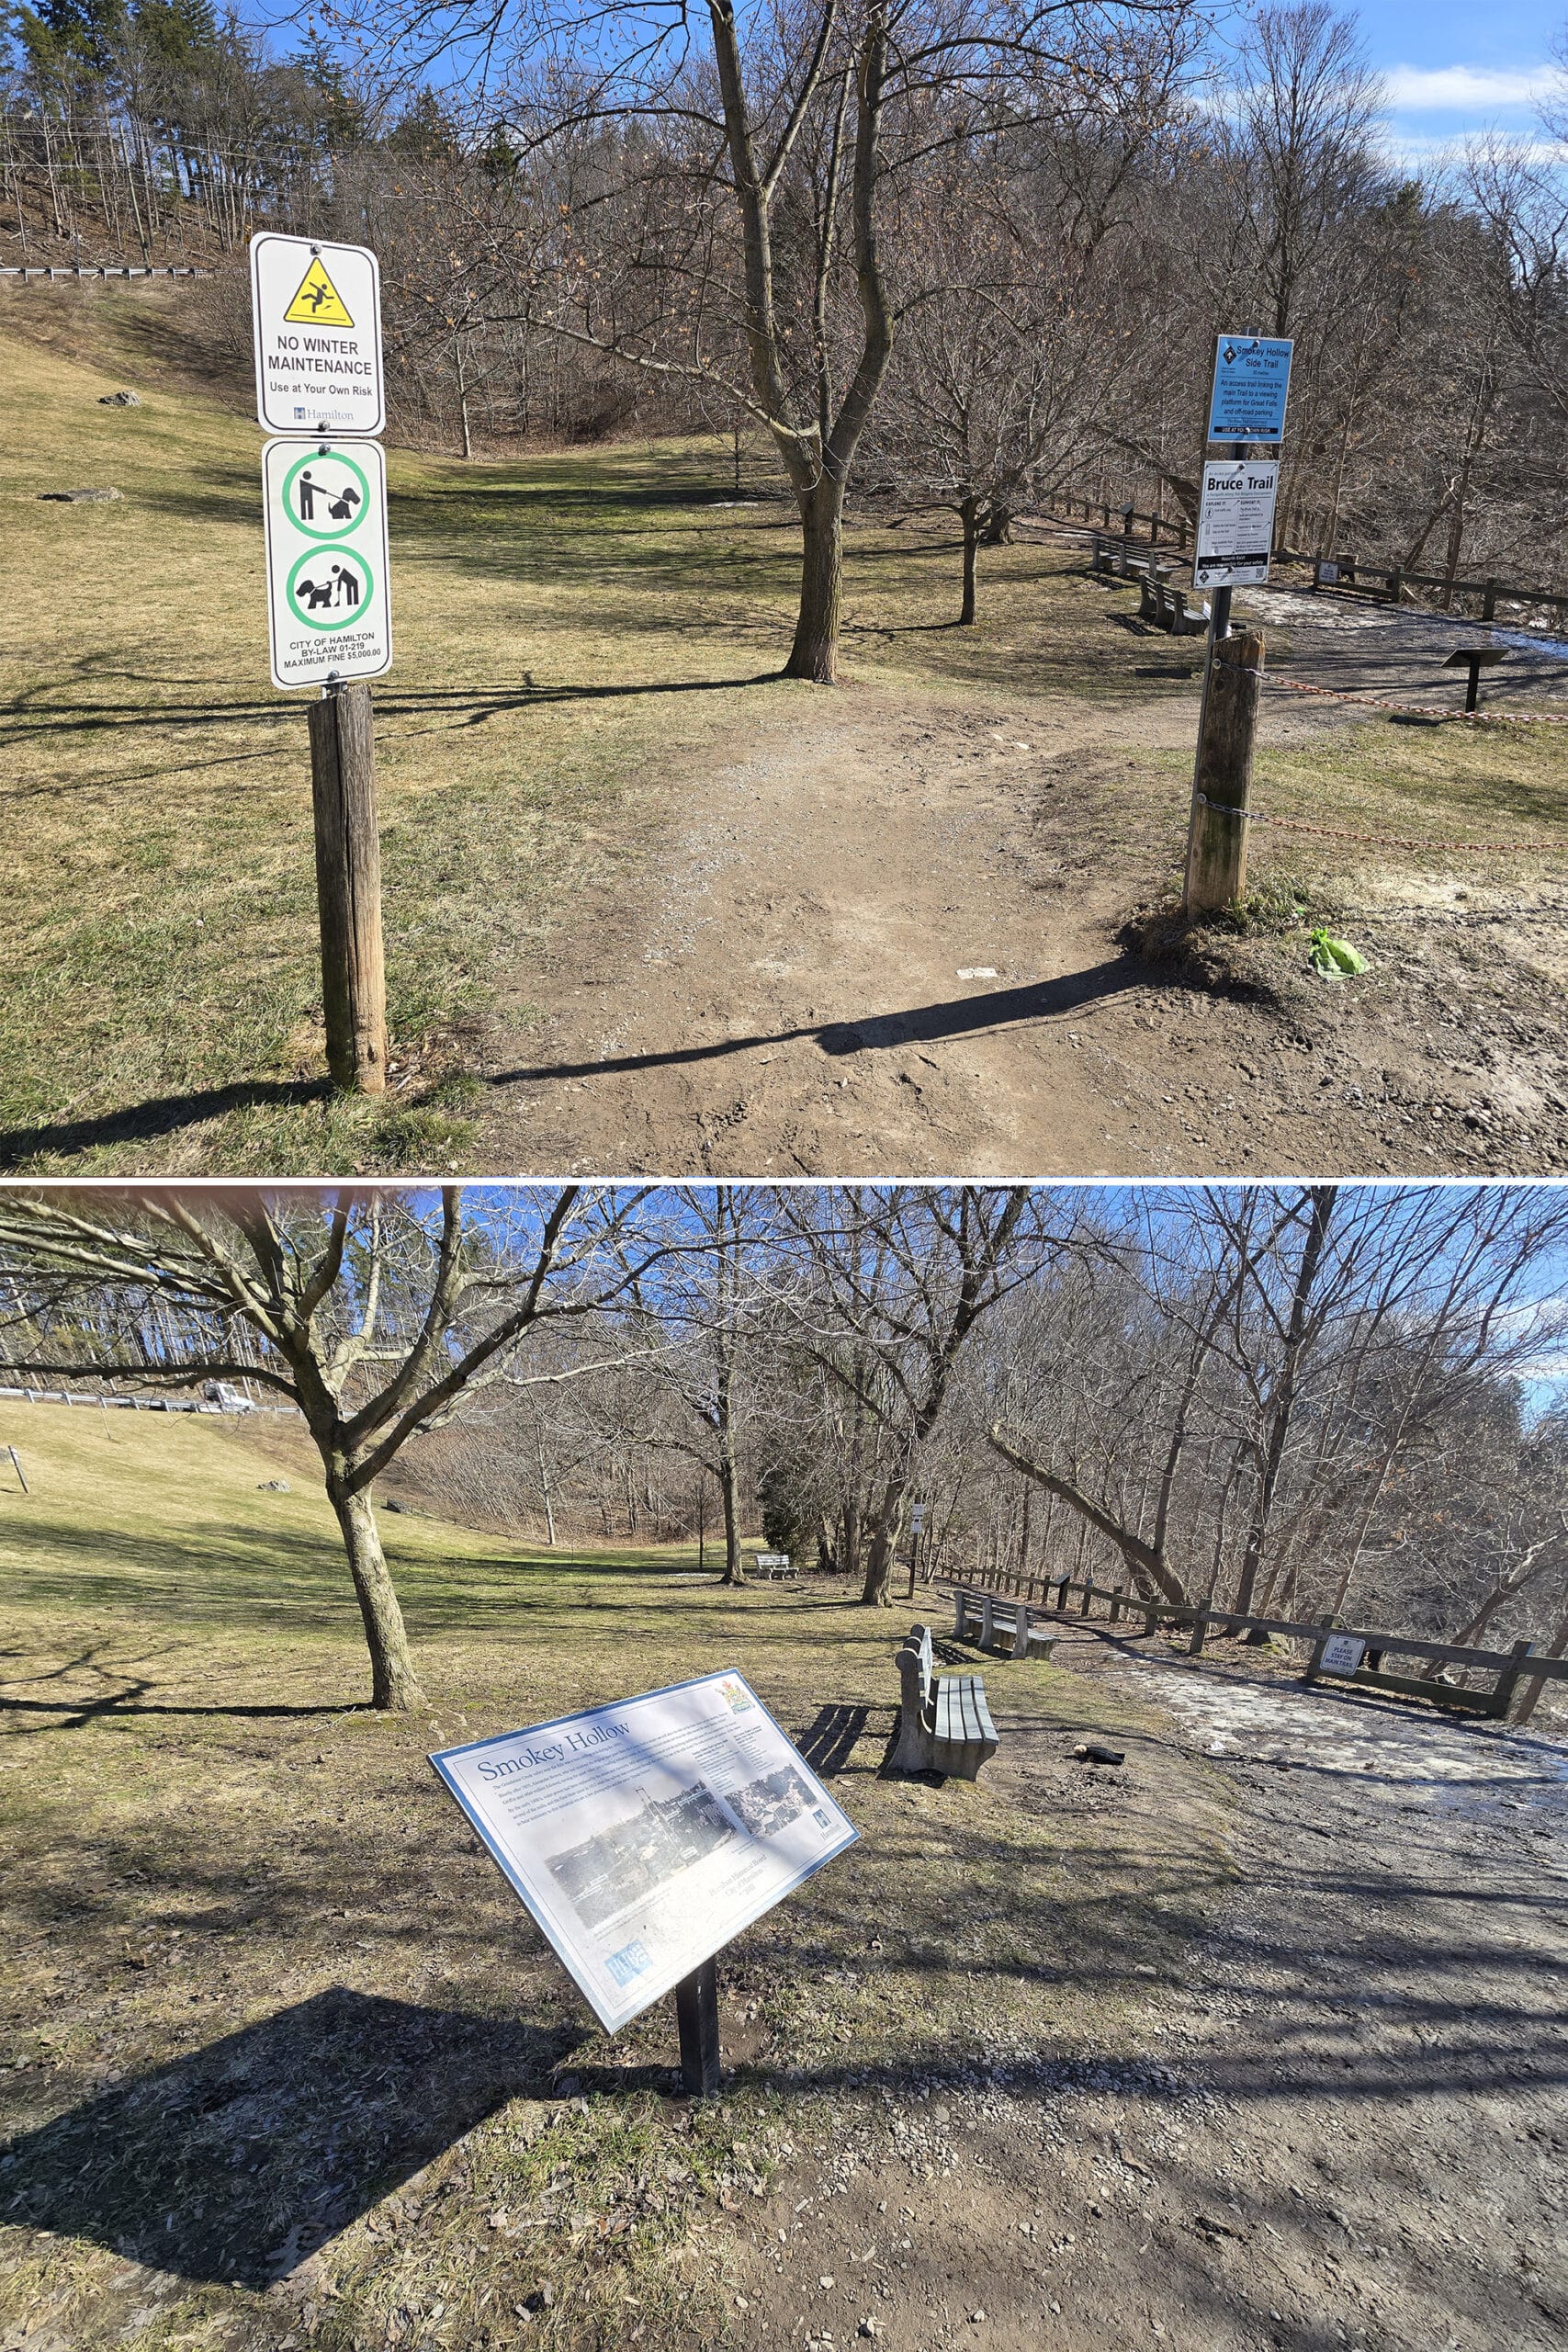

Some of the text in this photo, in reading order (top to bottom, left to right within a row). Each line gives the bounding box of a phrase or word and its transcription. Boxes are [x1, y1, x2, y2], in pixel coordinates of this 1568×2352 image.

[277, 335, 358, 355] NO WINTER
[1236, 345, 1290, 357] Smokey Hollow
[268, 356, 372, 375] MAINTENANCE
[1246, 358, 1279, 368] Side Trail
[270, 382, 373, 396] Use at Your Own Risk
[1258, 380, 1273, 390] linking
[307, 409, 354, 420] Hamilton
[1207, 476, 1273, 491] Bruce Trail
[289, 632, 375, 650] CITY OF HAMILTON
[301, 641, 365, 658] BY-LAW 01-219
[285, 649, 381, 669] MAXIMUM FINE $5,000.00
[1334, 1646, 1352, 1655] PLEASE
[1339, 1660, 1352, 1668] TRAIL
[478, 1744, 564, 1781] Smokey
[564, 1722, 630, 1753] Hollow
